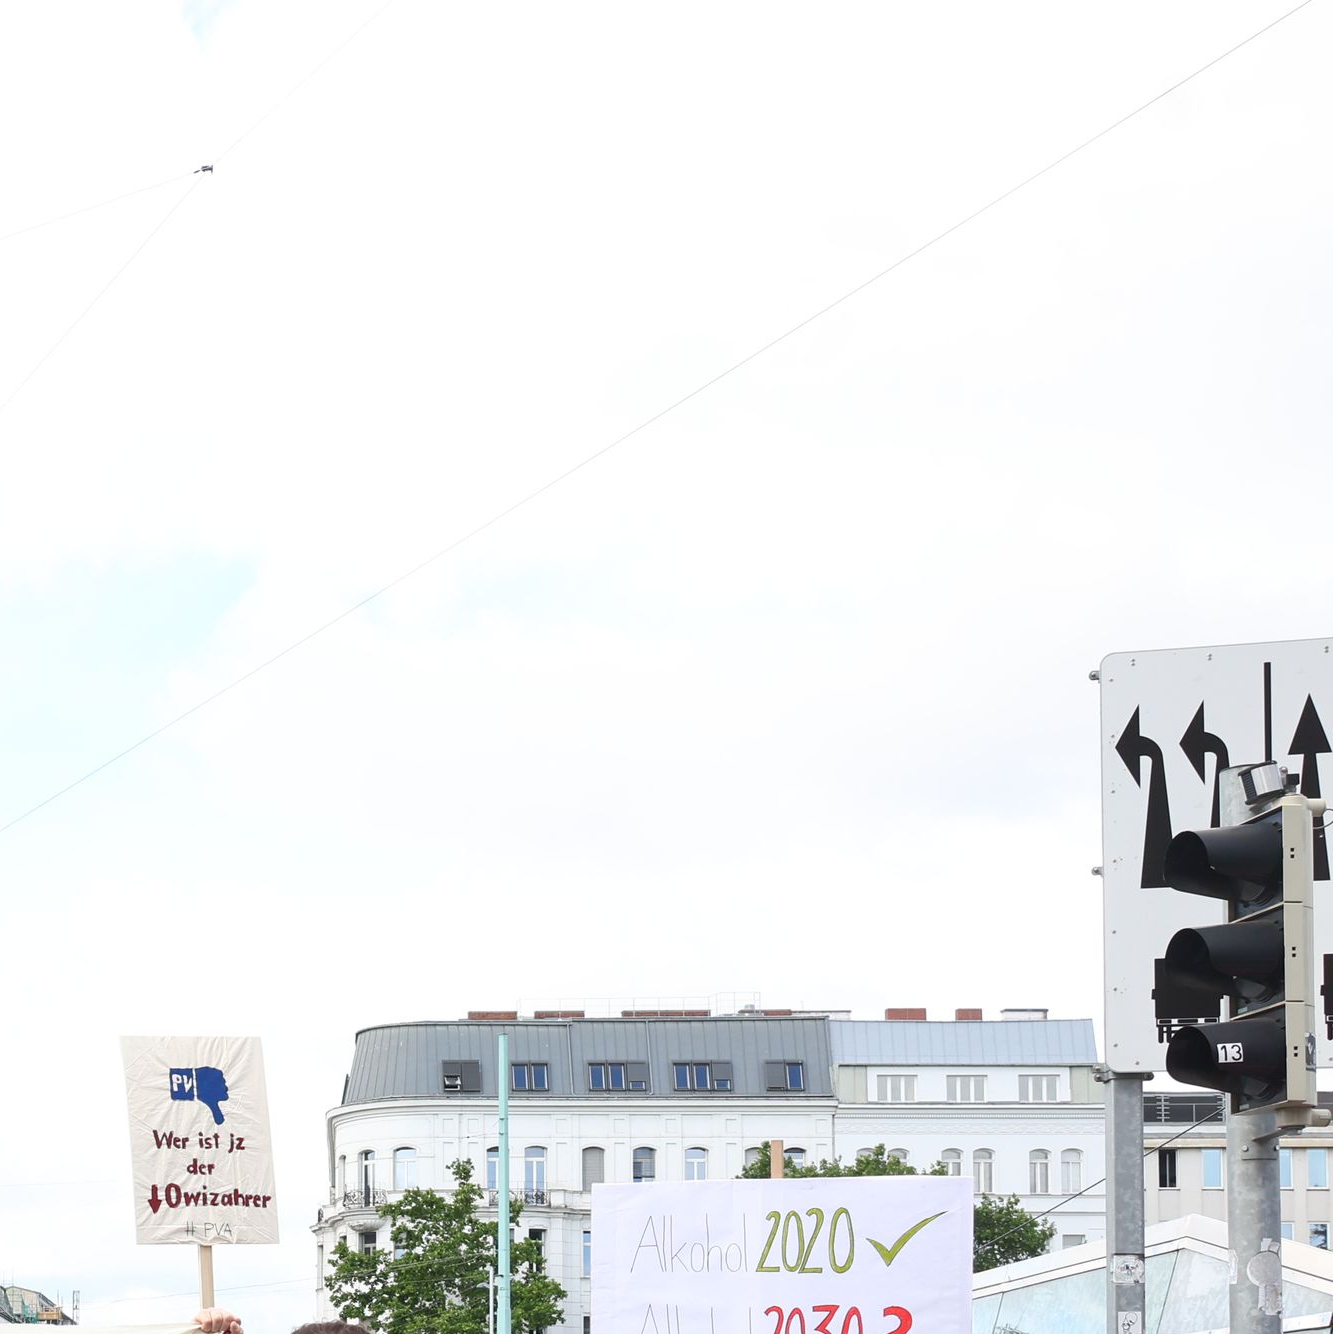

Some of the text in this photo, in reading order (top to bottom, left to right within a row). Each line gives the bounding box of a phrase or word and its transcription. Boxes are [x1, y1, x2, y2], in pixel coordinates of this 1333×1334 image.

[1221, 1045, 1242, 1061] 13
[152, 1130, 246, 1153] Wer ist jz
[186, 1158, 215, 1175] der
[204, 1222, 233, 1237] PVA
[630, 1207, 855, 1274] Alkohol 2020
